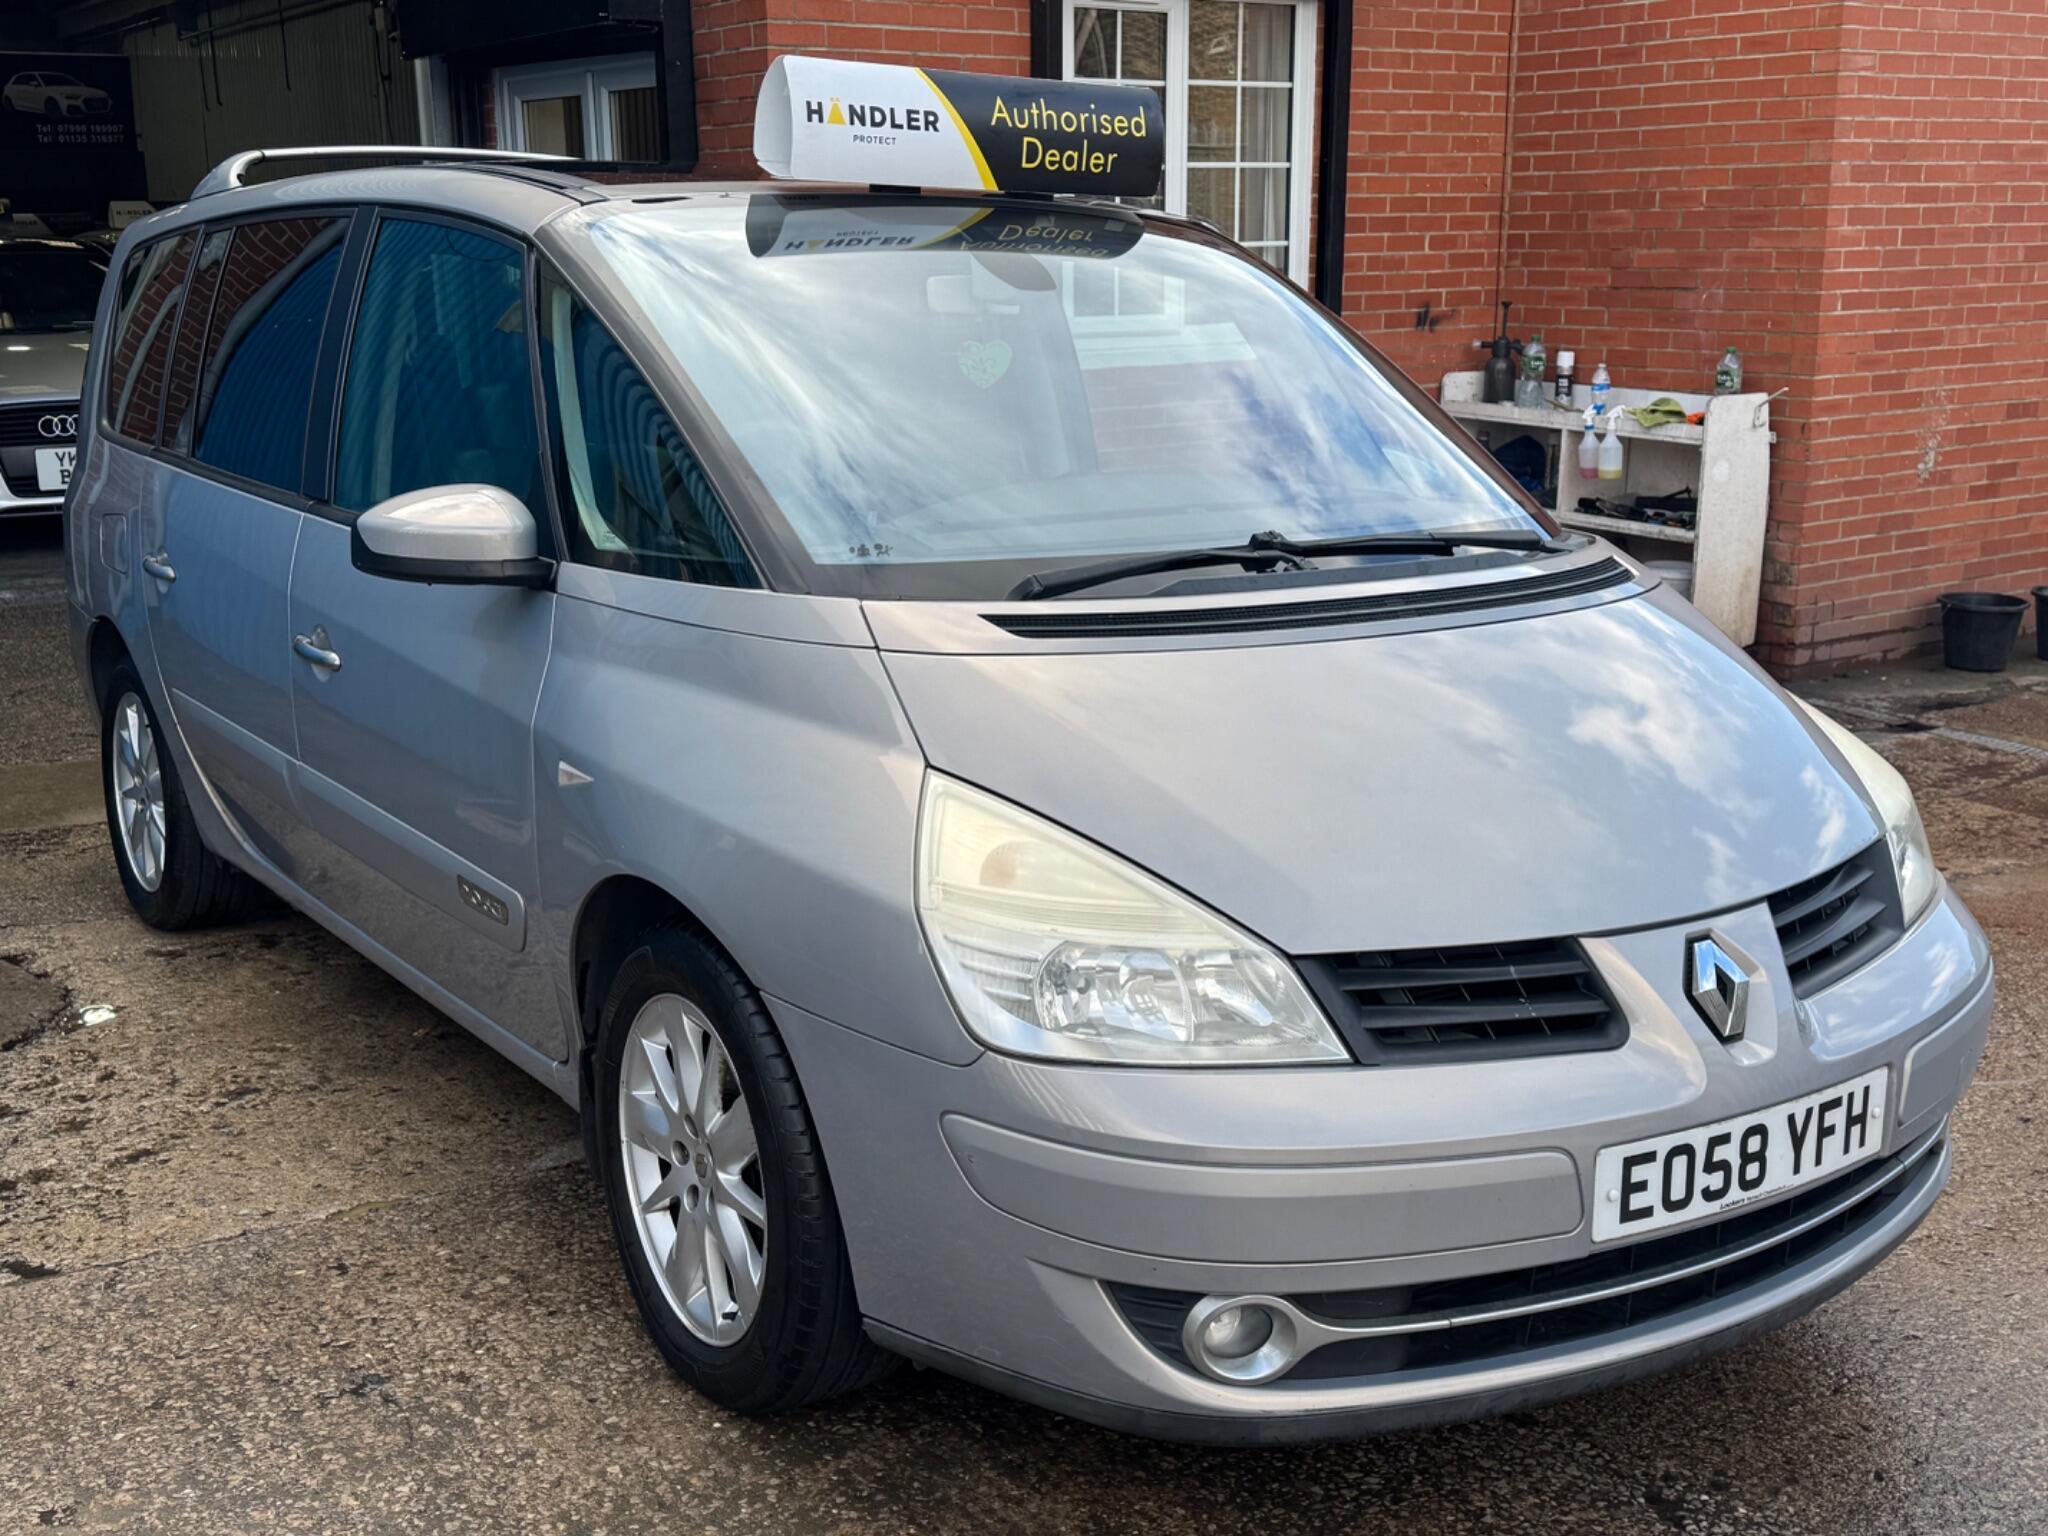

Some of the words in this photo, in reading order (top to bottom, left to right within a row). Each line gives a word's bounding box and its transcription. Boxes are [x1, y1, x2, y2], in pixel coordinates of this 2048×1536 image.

[991, 96, 1147, 137] Authorised
[852, 134, 897, 146] PROTECT
[1021, 136, 1118, 173] Dealer
[1618, 1122, 1769, 1225] EO58
[1787, 1085, 1871, 1176] YFH
